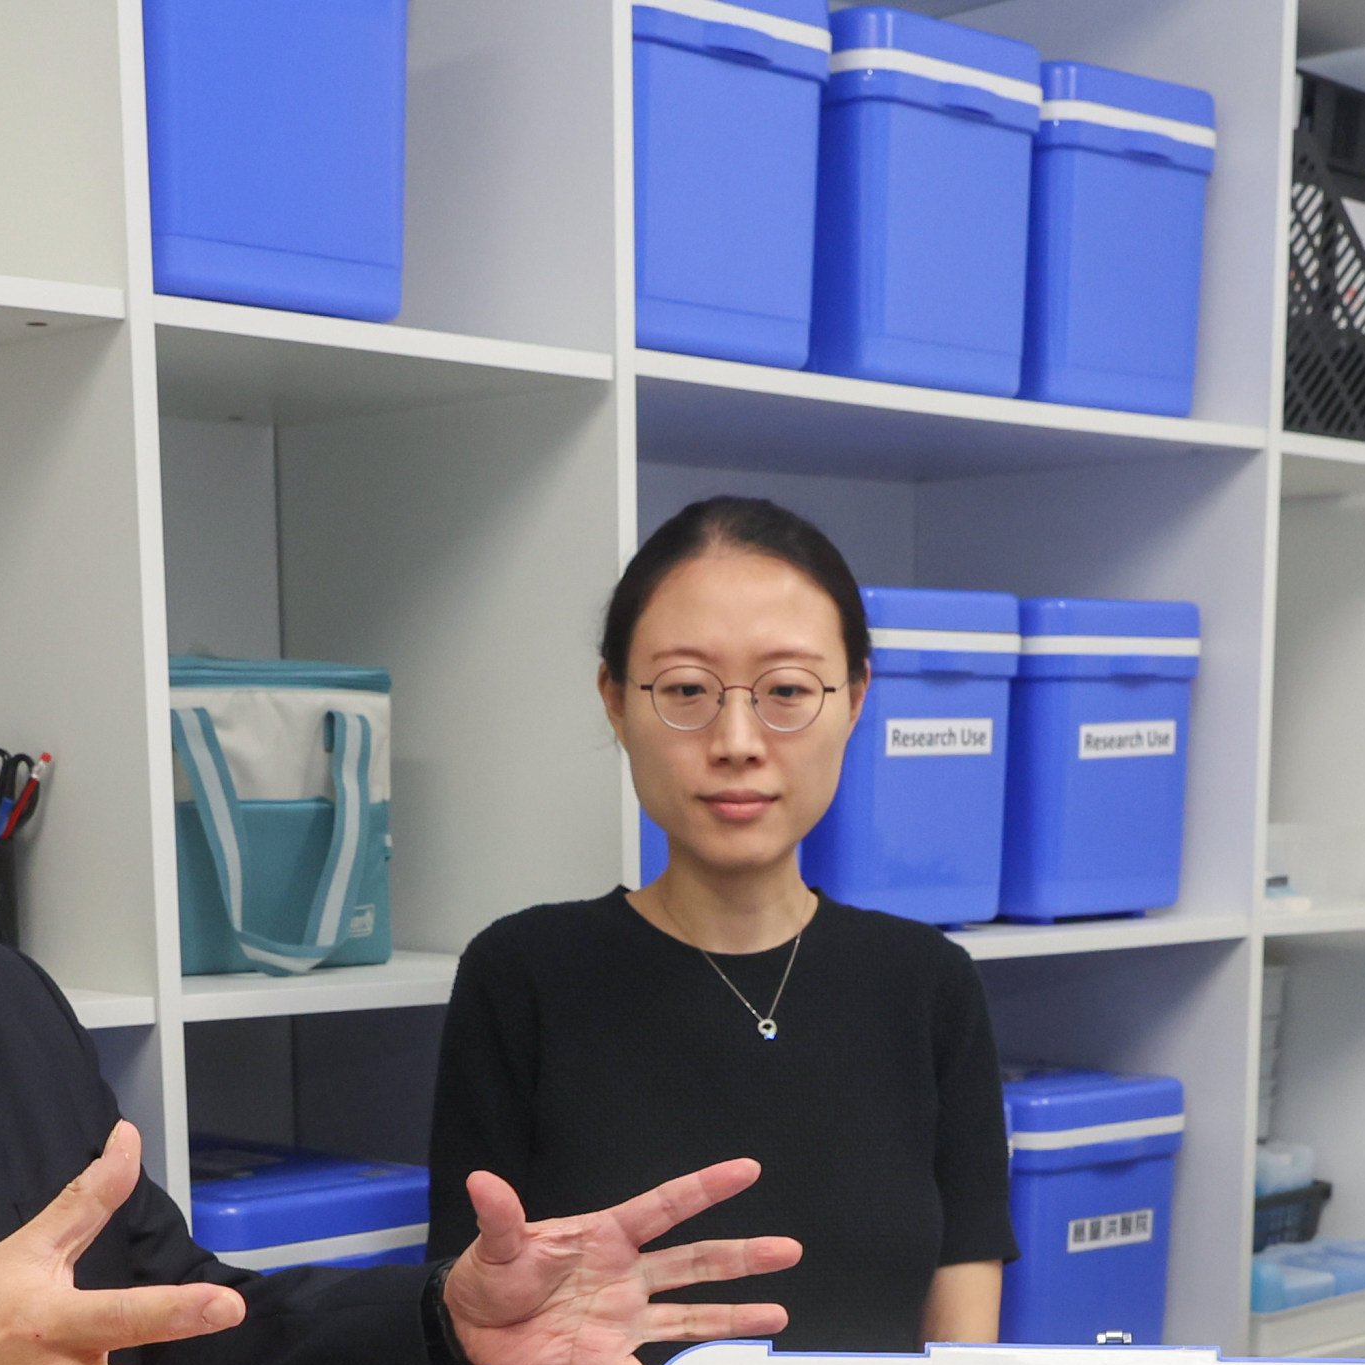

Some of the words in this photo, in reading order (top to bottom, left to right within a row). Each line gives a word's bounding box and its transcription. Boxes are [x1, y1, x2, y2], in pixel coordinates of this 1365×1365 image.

[891, 728, 957, 748] Research
[961, 728, 986, 748] Use
[1084, 732, 1143, 751] Research
[1147, 731, 1172, 748] Use
